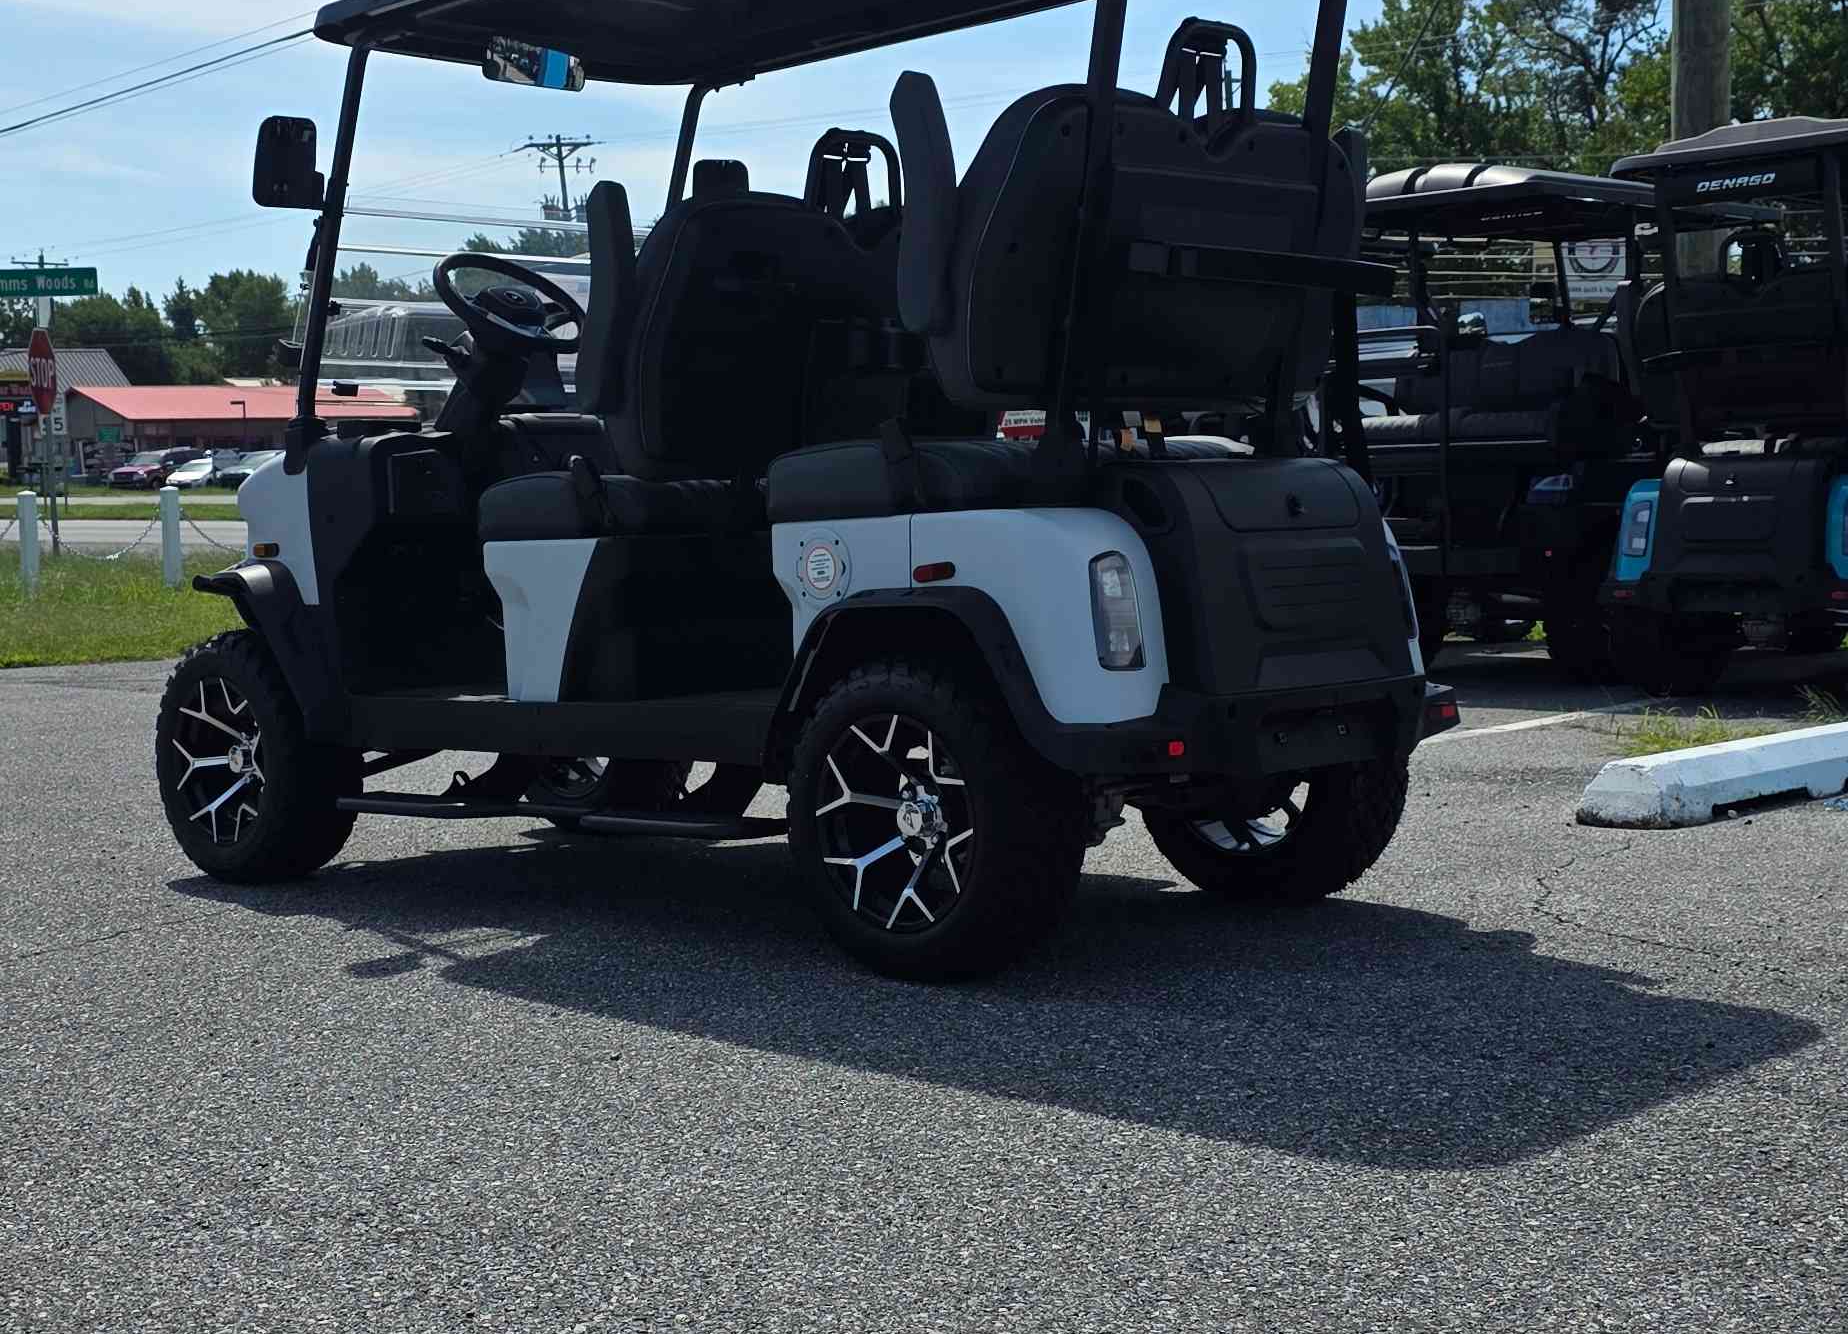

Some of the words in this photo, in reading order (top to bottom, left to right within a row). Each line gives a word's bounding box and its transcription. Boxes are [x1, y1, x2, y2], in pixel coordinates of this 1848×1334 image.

[1696, 173, 1776, 193] DENAGO
[36, 274, 77, 290] Woods
[31, 357, 54, 387] STOP
